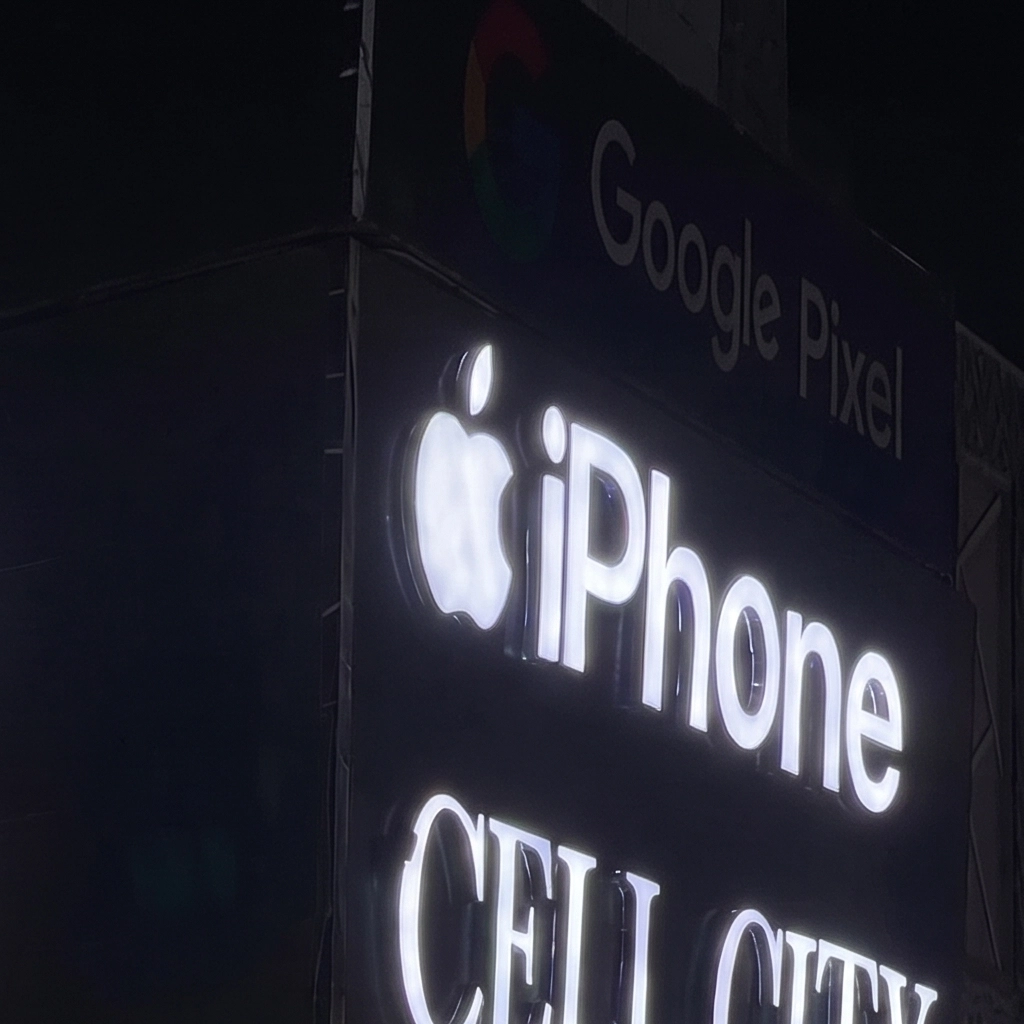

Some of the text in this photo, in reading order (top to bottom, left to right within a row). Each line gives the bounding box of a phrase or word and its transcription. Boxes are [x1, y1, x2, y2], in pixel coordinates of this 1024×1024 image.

[590, 118, 903, 460] Google Pixel
[537, 405, 904, 814] iPhone
